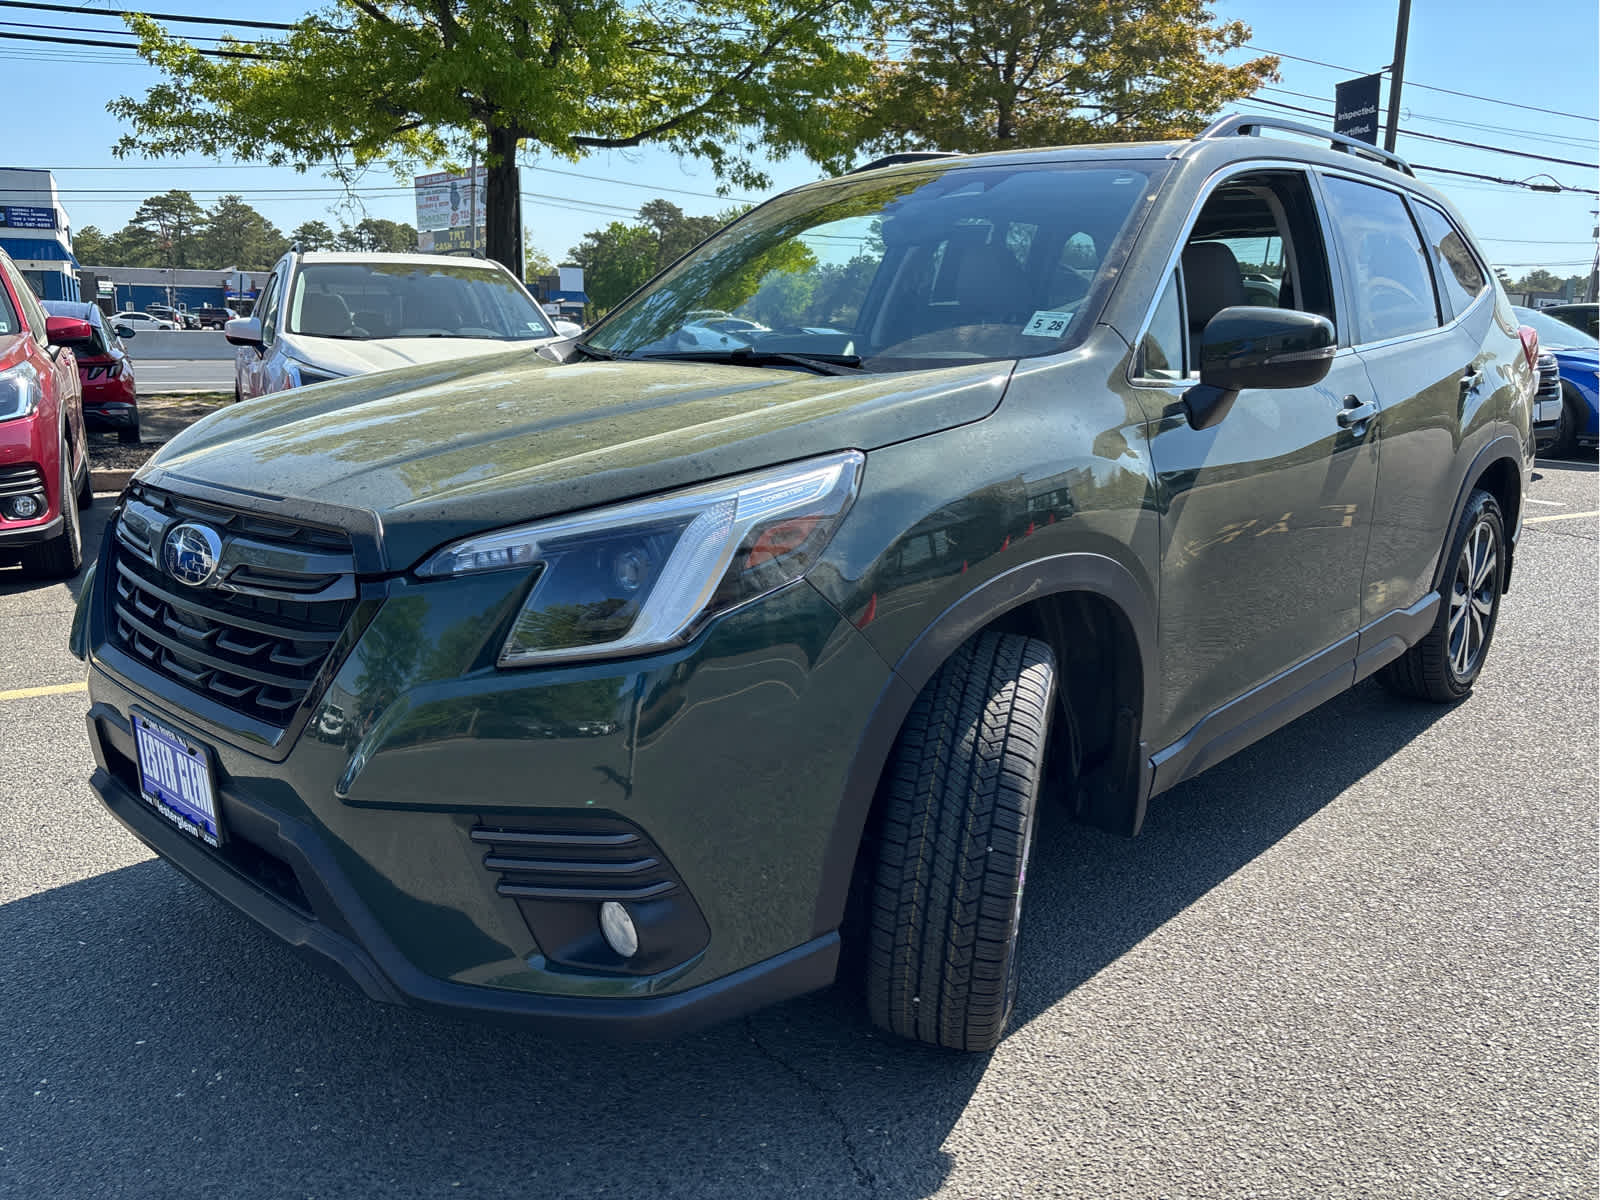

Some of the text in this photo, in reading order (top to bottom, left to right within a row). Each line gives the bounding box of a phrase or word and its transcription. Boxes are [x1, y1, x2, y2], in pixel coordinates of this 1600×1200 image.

[1337, 104, 1377, 121] Inspected.
[1033, 319, 1065, 331] 5 28
[760, 486, 804, 503] FORESTER
[136, 728, 215, 818] LESTER GLENN
